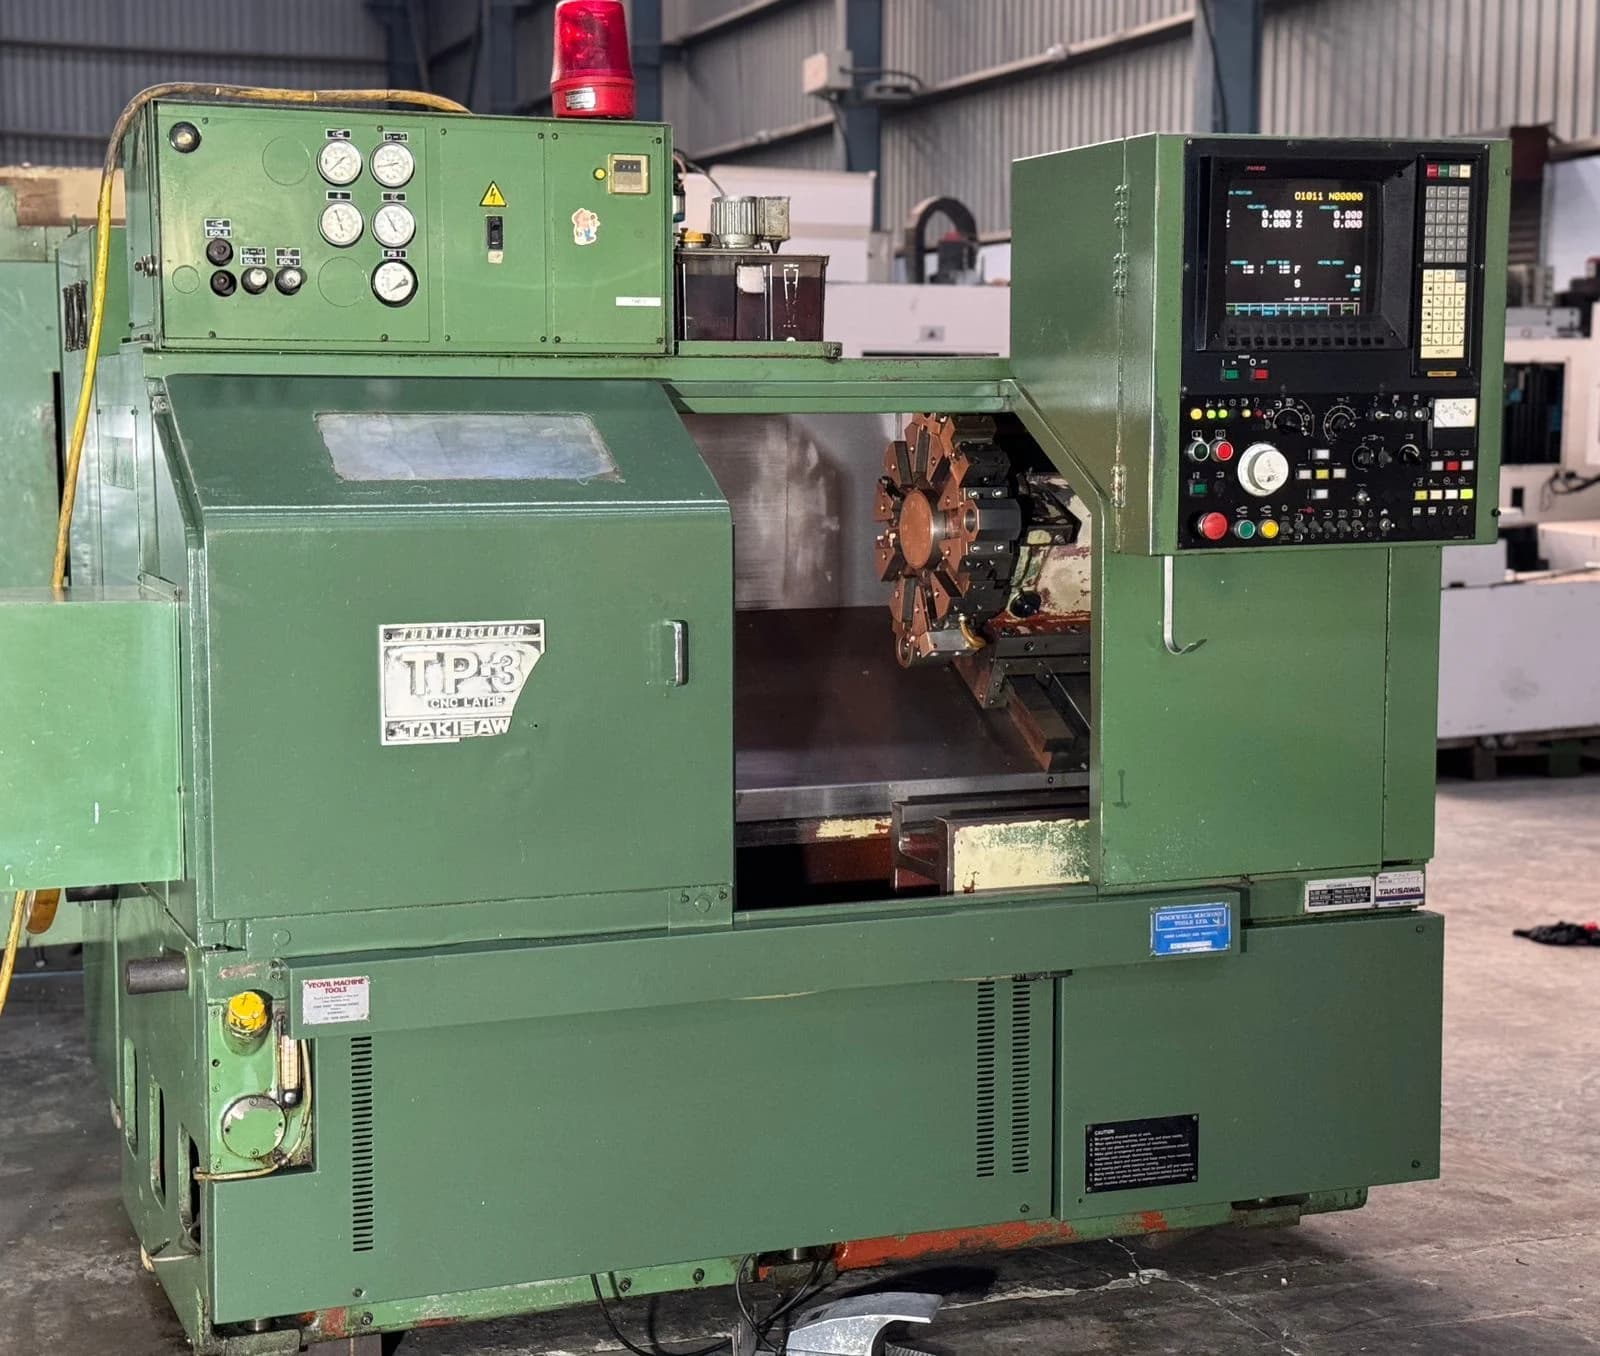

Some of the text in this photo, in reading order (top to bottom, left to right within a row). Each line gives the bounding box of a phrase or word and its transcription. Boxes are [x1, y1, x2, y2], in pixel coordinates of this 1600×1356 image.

[1328, 191, 1364, 201] N00000
[1262, 209, 1363, 219] 0.000 X 0.000
[1261, 219, 1363, 228] 0.000 Z 0.000
[1294, 265, 1301, 274] F
[1354, 265, 1361, 274] 0
[1354, 279, 1361, 288] 0
[431, 697, 503, 708] CNC LATHE
[1379, 886, 1421, 895] TAKISAWA
[333, 979, 364, 987] MACHINE
[325, 986, 347, 994] TOOLS
